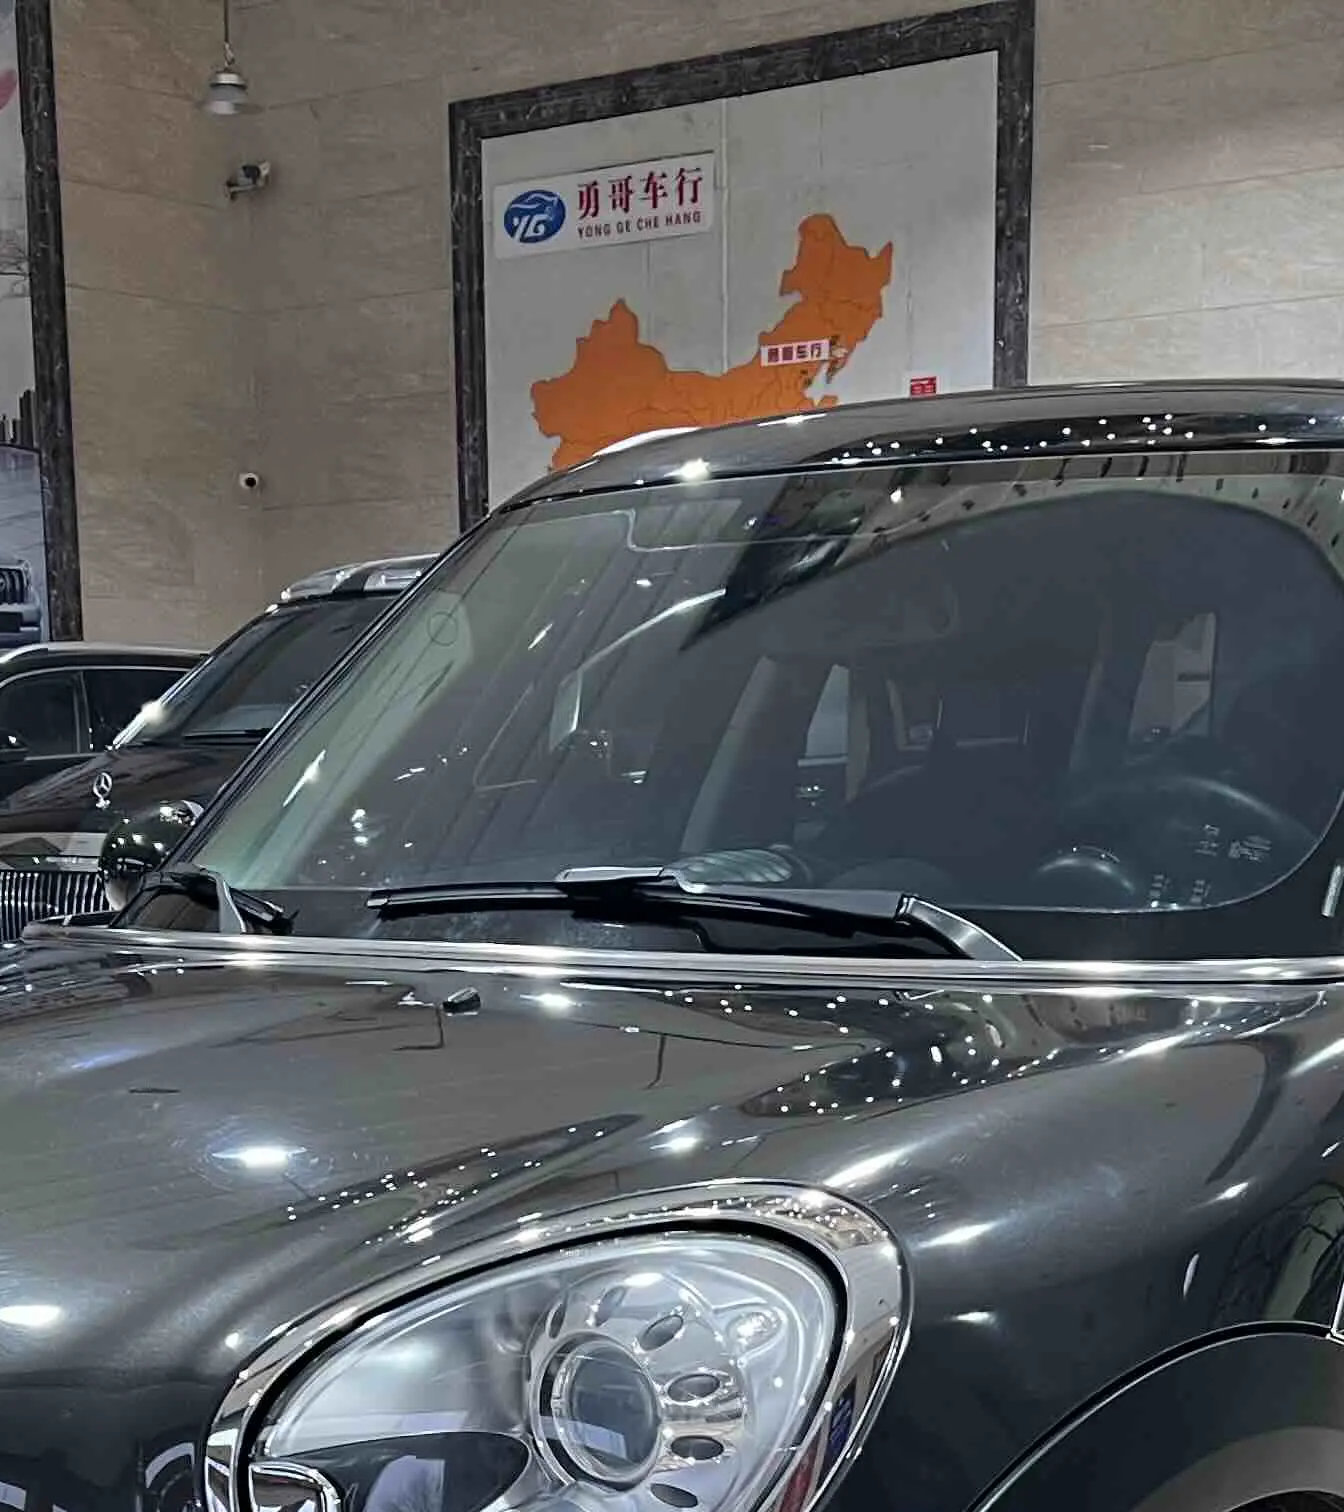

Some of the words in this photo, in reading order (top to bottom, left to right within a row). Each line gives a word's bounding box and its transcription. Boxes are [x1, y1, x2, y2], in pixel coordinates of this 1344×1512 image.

[577, 167, 703, 220] 勇哥车行
[577, 223, 611, 239] YONG
[617, 220, 632, 234] GE
[637, 216, 659, 231] CHE
[665, 210, 702, 226] HANG
